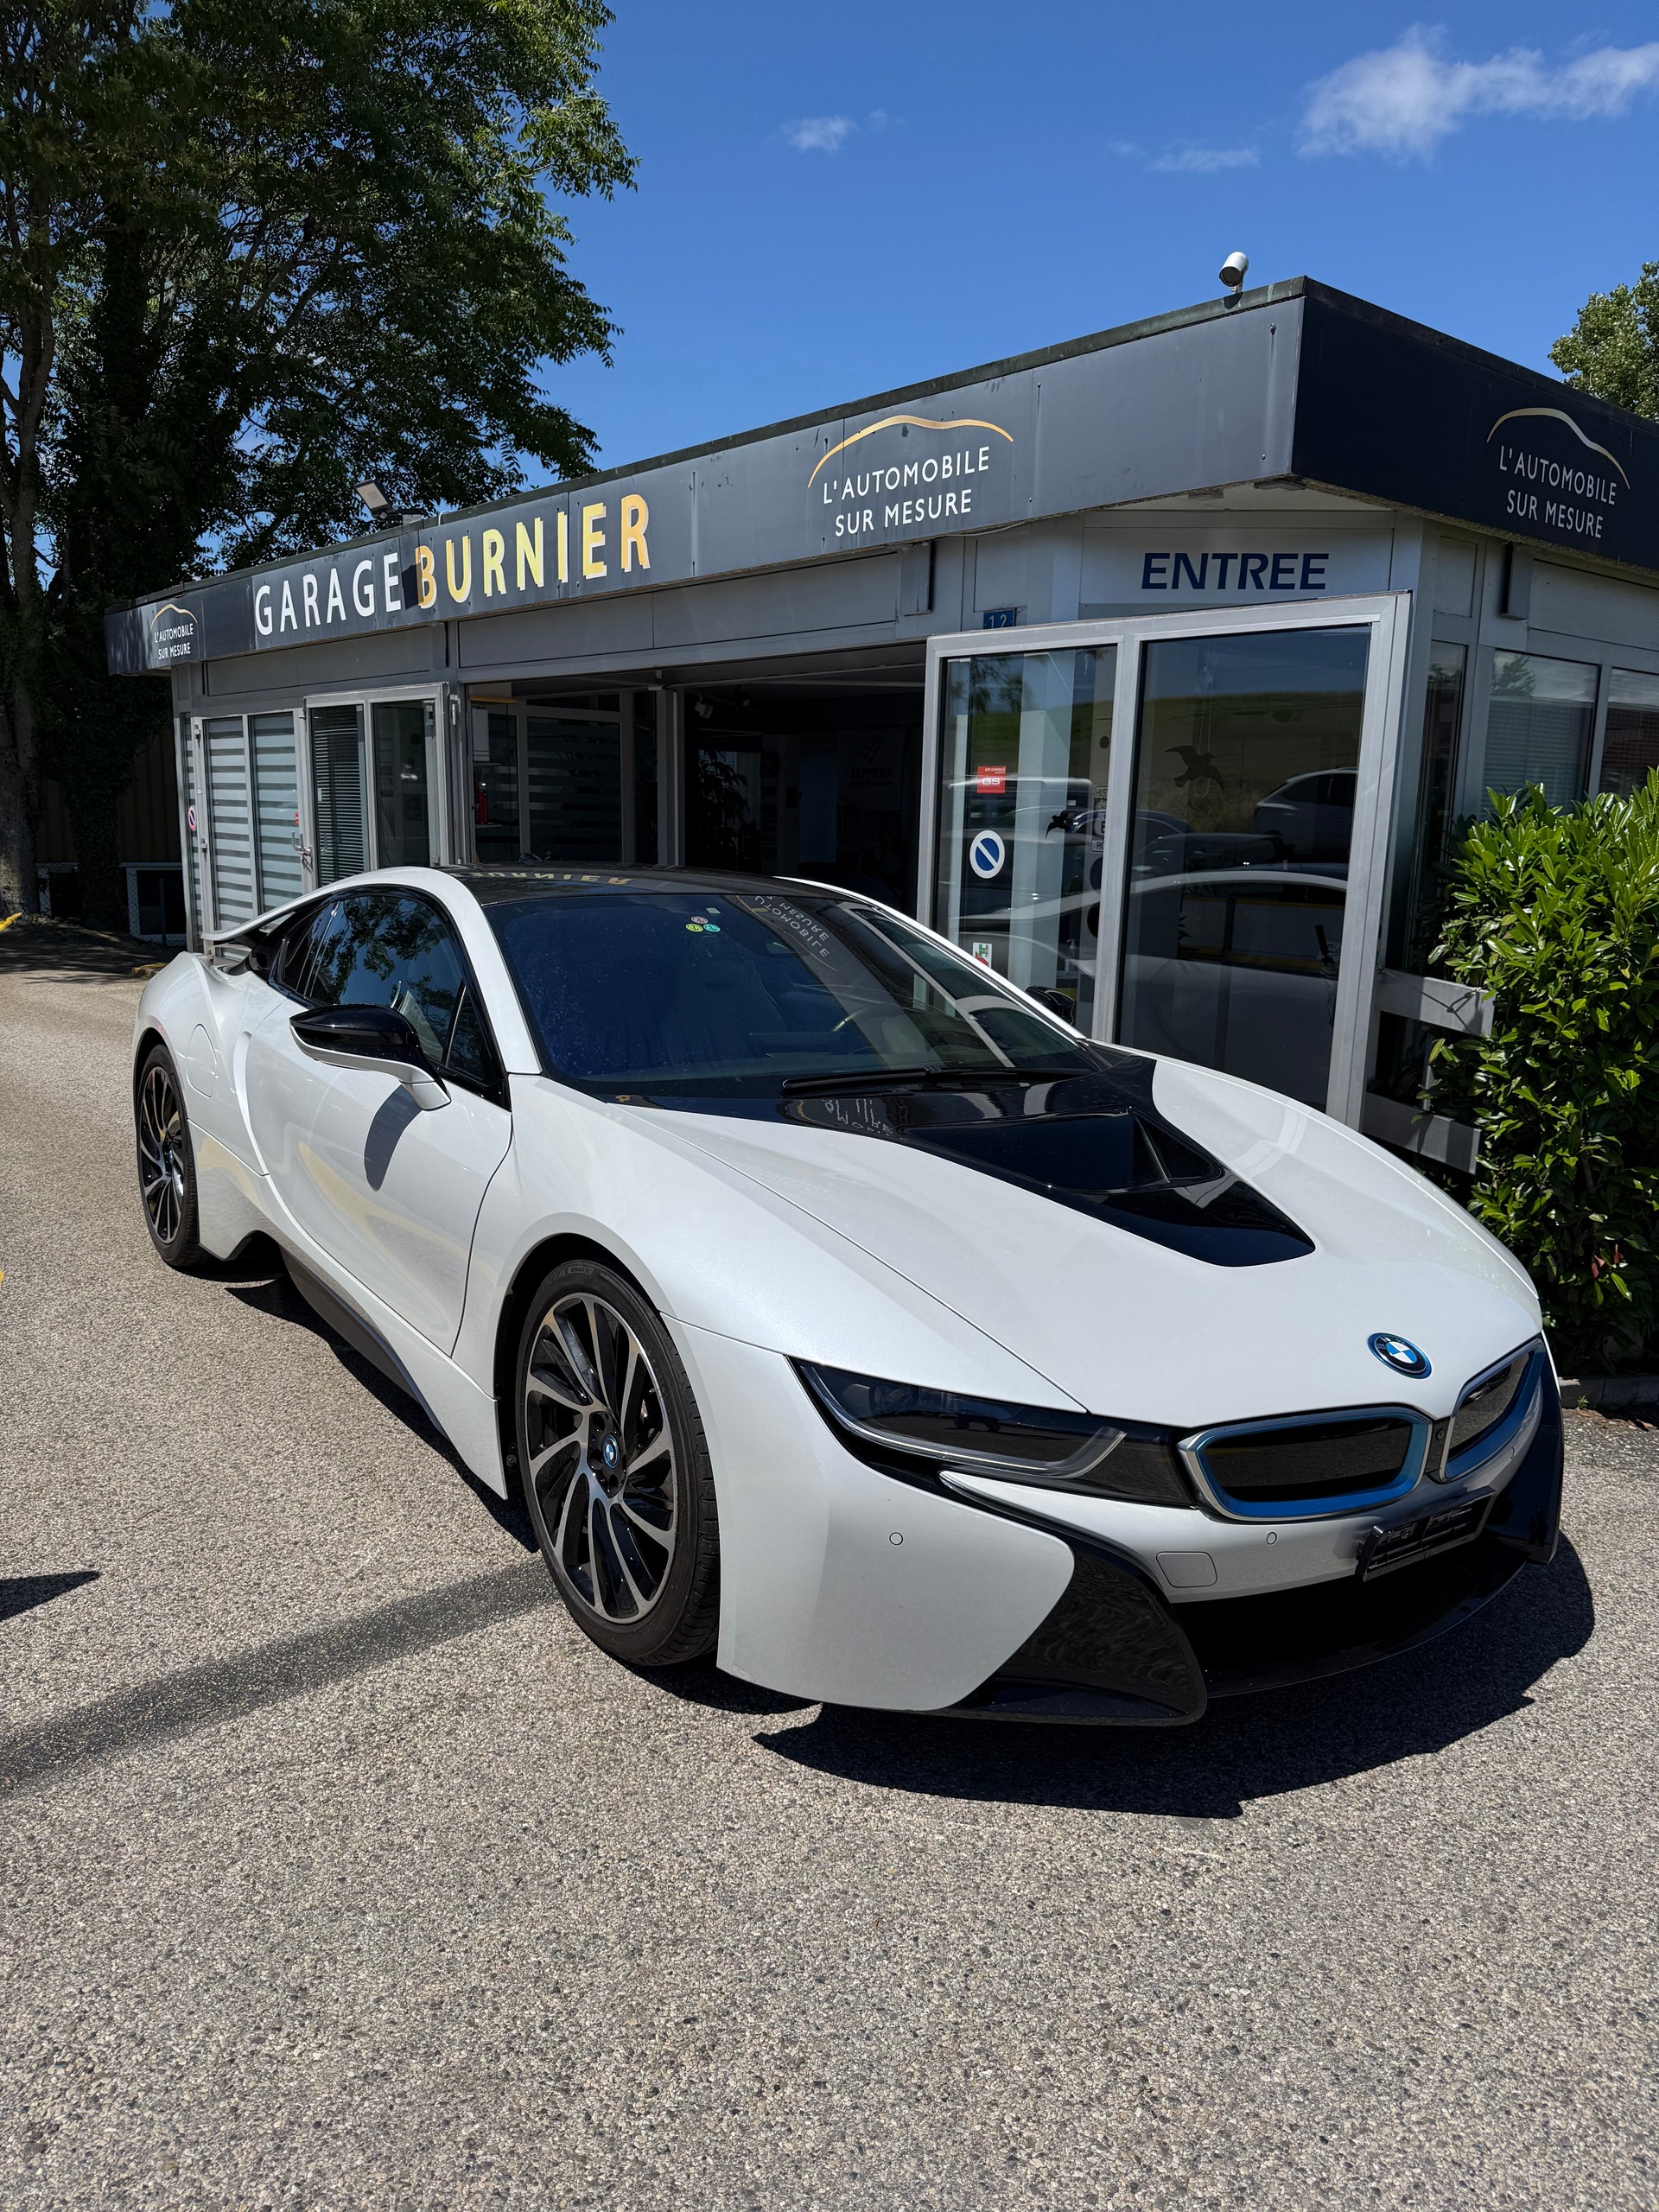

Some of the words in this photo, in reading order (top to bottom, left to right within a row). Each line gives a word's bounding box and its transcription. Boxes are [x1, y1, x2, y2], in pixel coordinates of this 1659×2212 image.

[823, 446, 989, 505] L'AUTOMOBILE
[1499, 445, 1617, 505] L'AUTOMOBILE
[835, 509, 874, 537] SUR
[884, 488, 972, 528] MESURE
[1506, 489, 1537, 520] SUR
[1545, 500, 1604, 539] MESURE
[255, 552, 401, 636] GARAGE
[415, 493, 650, 609] BURNIER
[1141, 552, 1330, 590] ENTREE
[154, 623, 194, 643] L'AUTOMOBILE
[988, 613, 1007, 629] 12
[158, 647, 169, 660] SUR
[169, 642, 191, 658] MESURE
